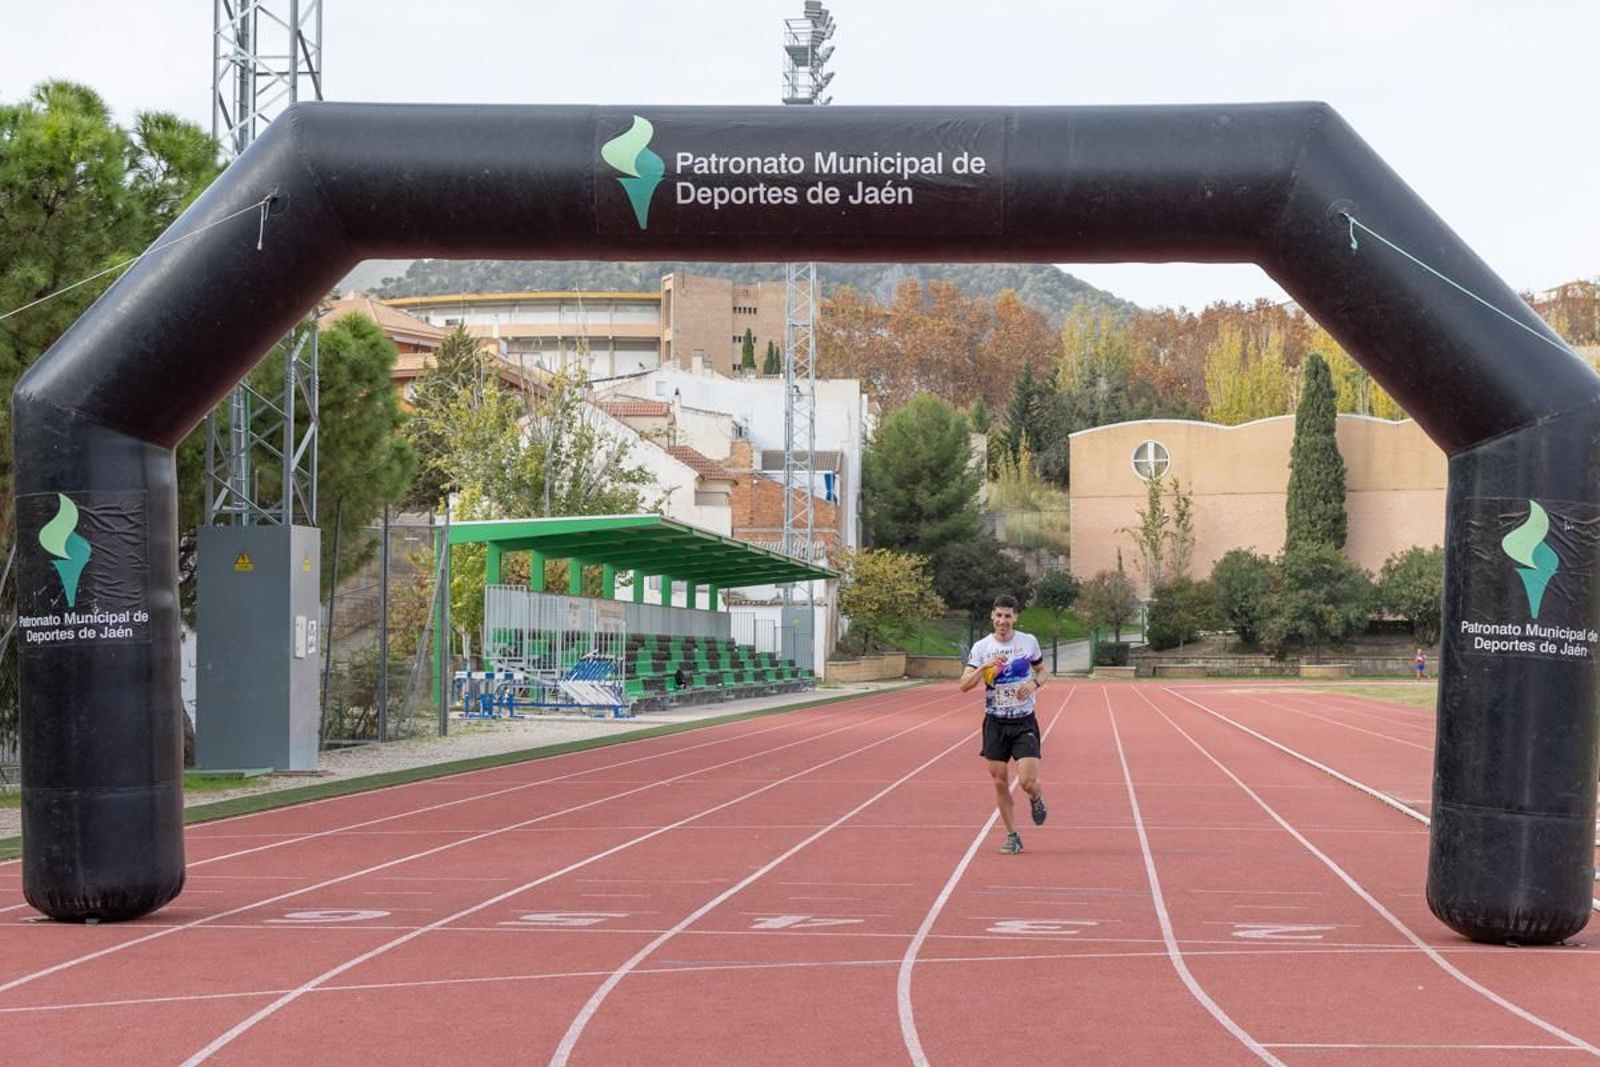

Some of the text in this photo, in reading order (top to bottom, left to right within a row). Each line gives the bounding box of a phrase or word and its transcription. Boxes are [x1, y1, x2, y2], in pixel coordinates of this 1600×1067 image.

[676, 151, 987, 182] Patronato Municipal de
[676, 179, 913, 209] Deportes de Jaén
[19, 610, 149, 628] Patronato Municipal de
[26, 625, 133, 644] Deportes de Jaén
[1460, 620, 1598, 642] Patronato Municipal de
[1474, 637, 1588, 657] Deportes de Jaén
[498, 912, 631, 927] 5
[750, 915, 866, 929] 4
[985, 919, 1099, 935] 3
[1231, 923, 1337, 940] 2
